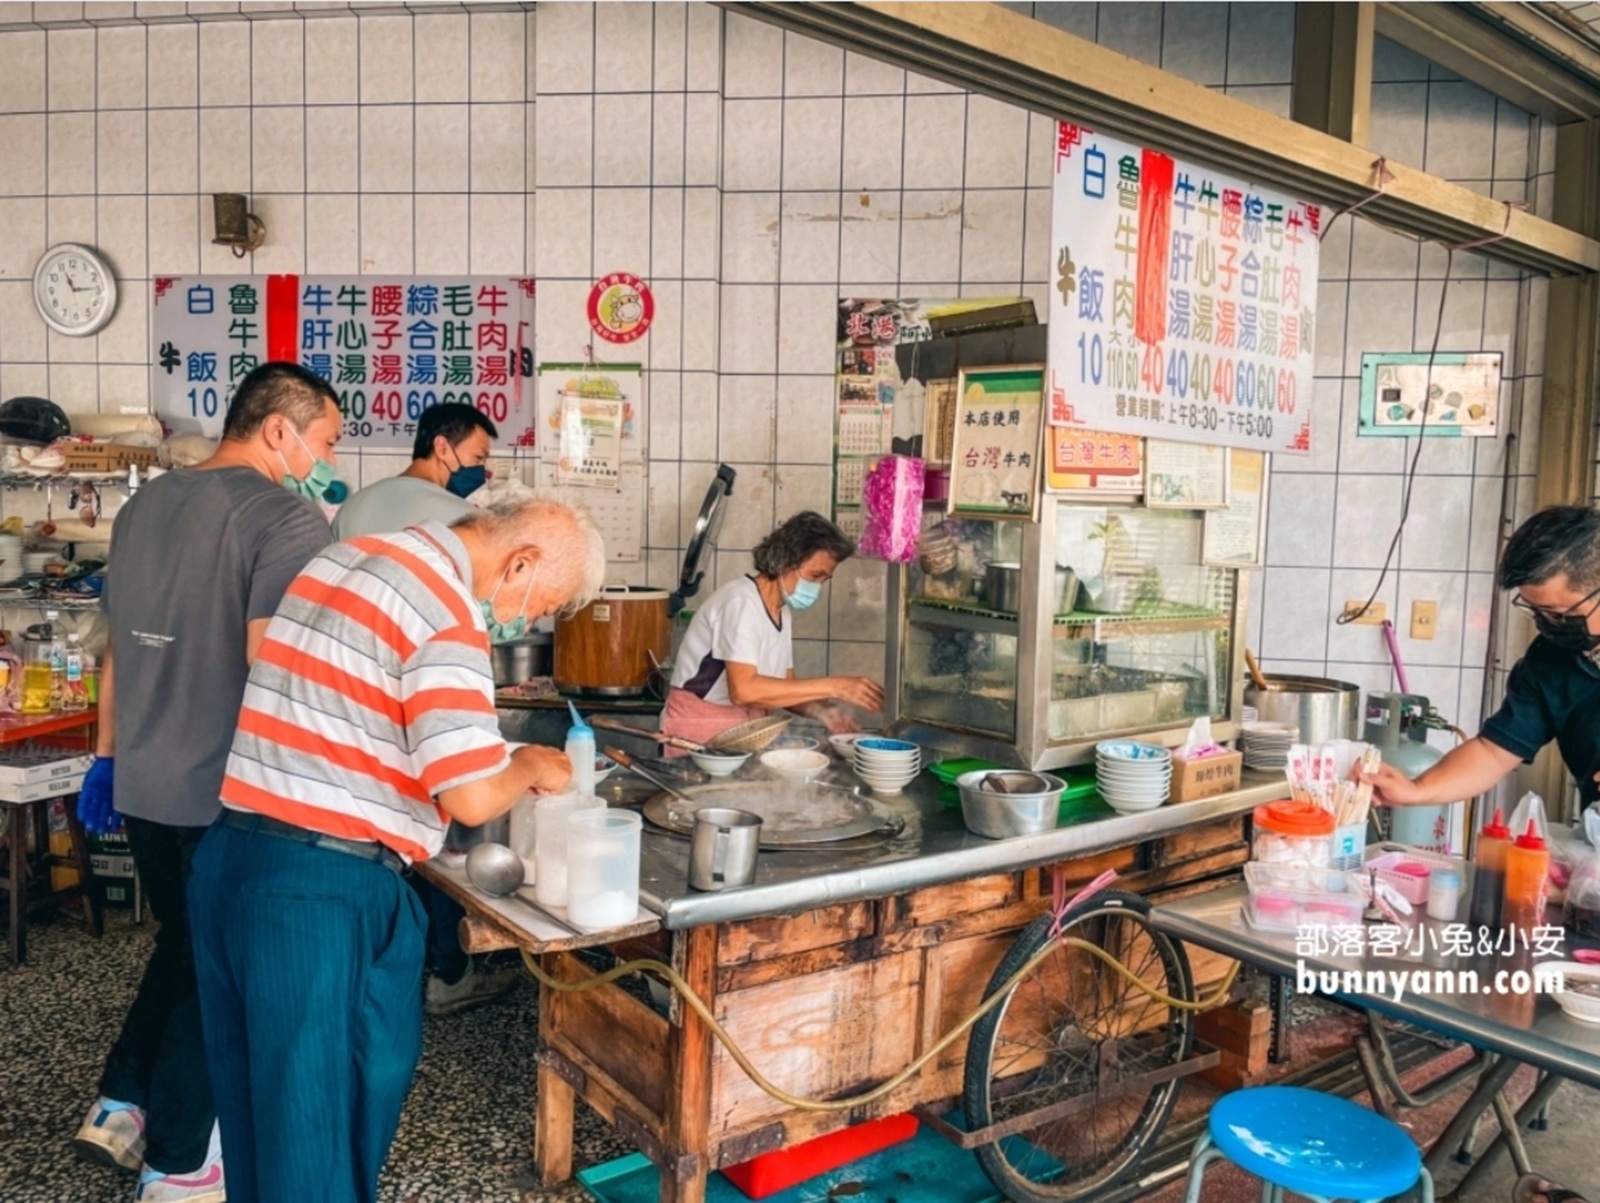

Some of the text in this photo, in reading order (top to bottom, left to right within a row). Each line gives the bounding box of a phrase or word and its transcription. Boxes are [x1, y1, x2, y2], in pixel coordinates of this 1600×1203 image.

[1077, 143, 1107, 386] 白飯 10
[1112, 154, 1141, 330] 魯牛肉
[1166, 171, 1196, 399] 牛肝湯 40
[1190, 179, 1220, 402] 牛心湯 40
[1213, 188, 1243, 406] 腰子湯 40
[1235, 193, 1264, 409] 綜合湯 60
[1256, 203, 1283, 412] 毛肚湯 60
[159, 341, 182, 375] 牛
[186, 284, 218, 417] 白飯 10
[228, 284, 259, 383] 魯牛肉
[302, 284, 333, 383] 牛肝湯
[336, 284, 367, 420] 牛心湯 40
[371, 285, 403, 420] 腰子湯 40
[406, 285, 438, 385] 綜合湯
[442, 285, 474, 386] 毛肚湯
[476, 285, 508, 422] 牛肉湯 60
[1106, 348, 1139, 392] 110 60
[1108, 329, 1122, 346] 大
[1141, 345, 1164, 395] 40
[1277, 208, 1304, 415] 牛肉湯 60
[964, 409, 1020, 427] 本店使用
[965, 446, 1031, 469] 台灣牛肉
[1059, 440, 1132, 466] 台灣牛肉
